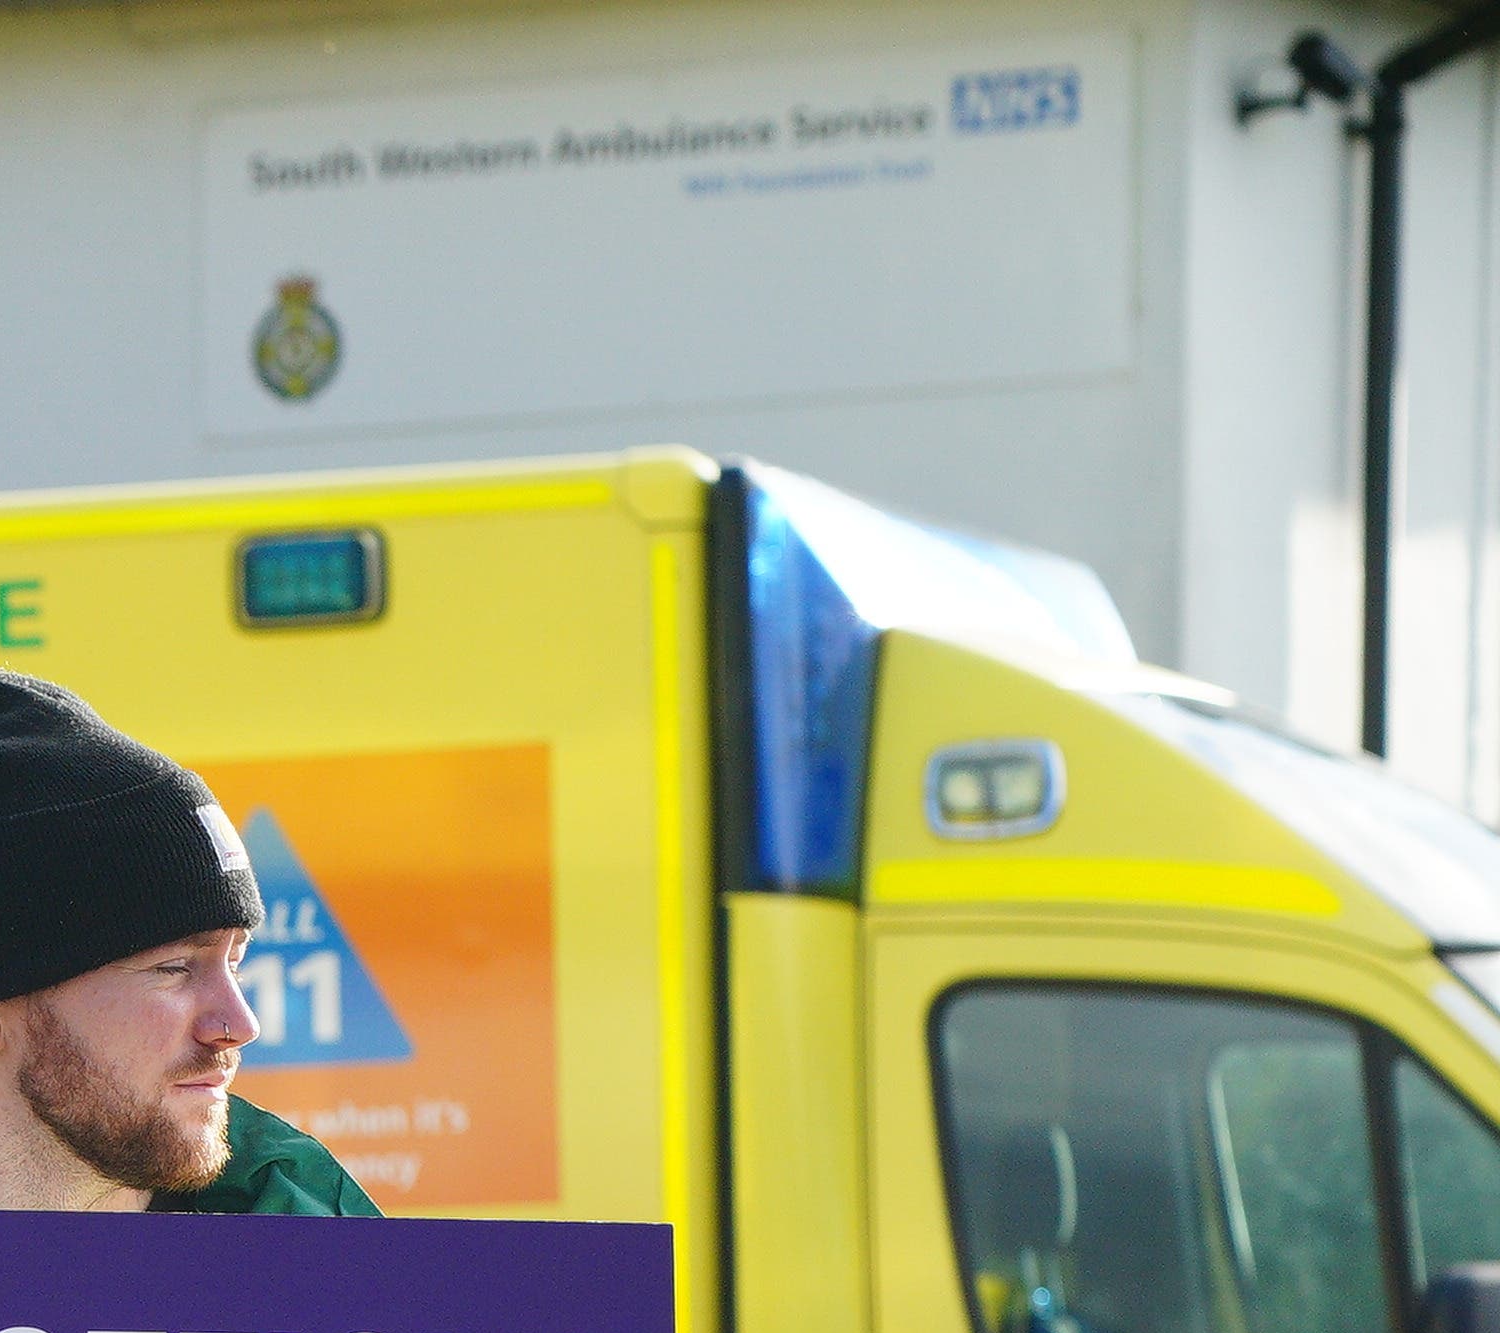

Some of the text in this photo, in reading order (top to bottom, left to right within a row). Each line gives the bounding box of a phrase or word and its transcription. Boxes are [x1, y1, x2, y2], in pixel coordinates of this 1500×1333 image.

[248, 150, 364, 190] South
[376, 140, 540, 180] Western
[549, 121, 777, 165] Ambulance
[790, 103, 932, 147] Service
[242, 952, 341, 1046] 11
